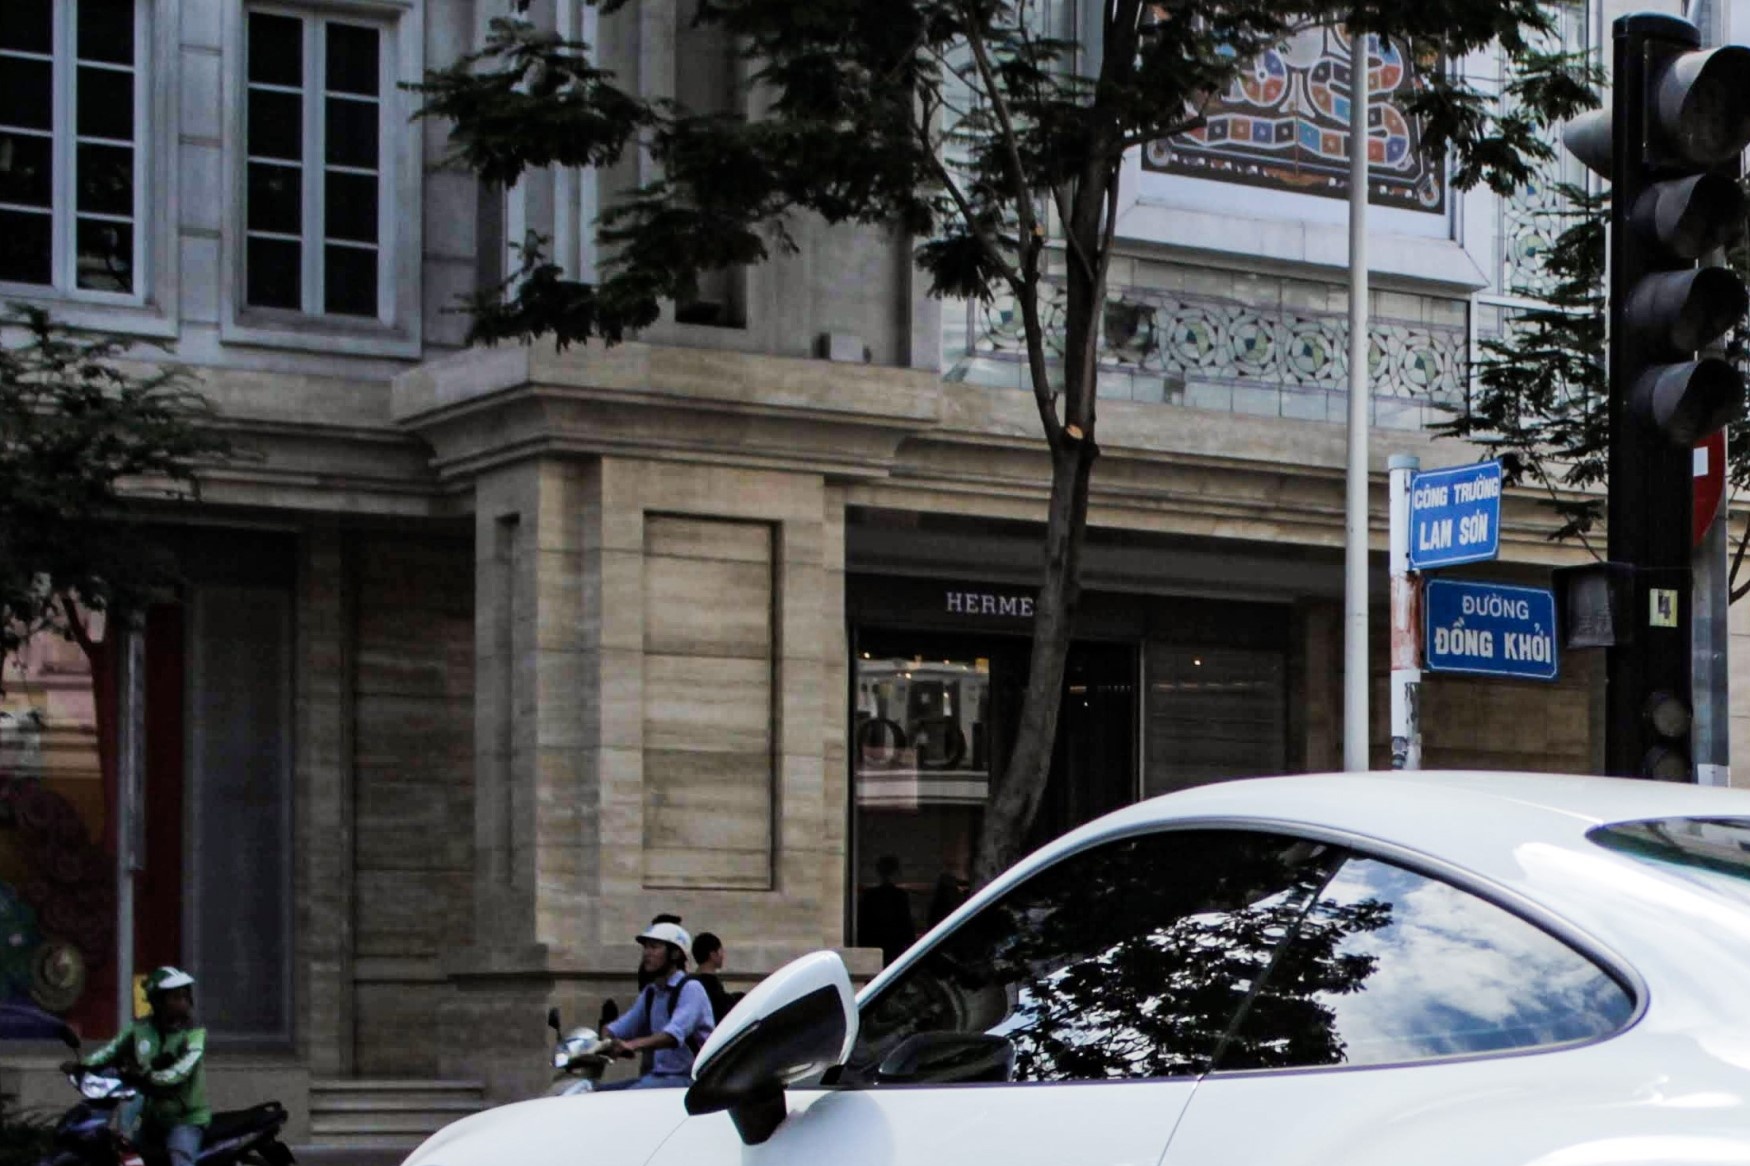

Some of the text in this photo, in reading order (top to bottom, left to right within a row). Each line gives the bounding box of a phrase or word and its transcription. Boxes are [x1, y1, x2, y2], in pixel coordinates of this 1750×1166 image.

[1419, 508, 1488, 551] LAM SƠN
[945, 591, 1034, 617] HERME
[1462, 592, 1529, 620] ĐƯỜNG
[1434, 616, 1551, 664] ĐỒNG KHỞI
